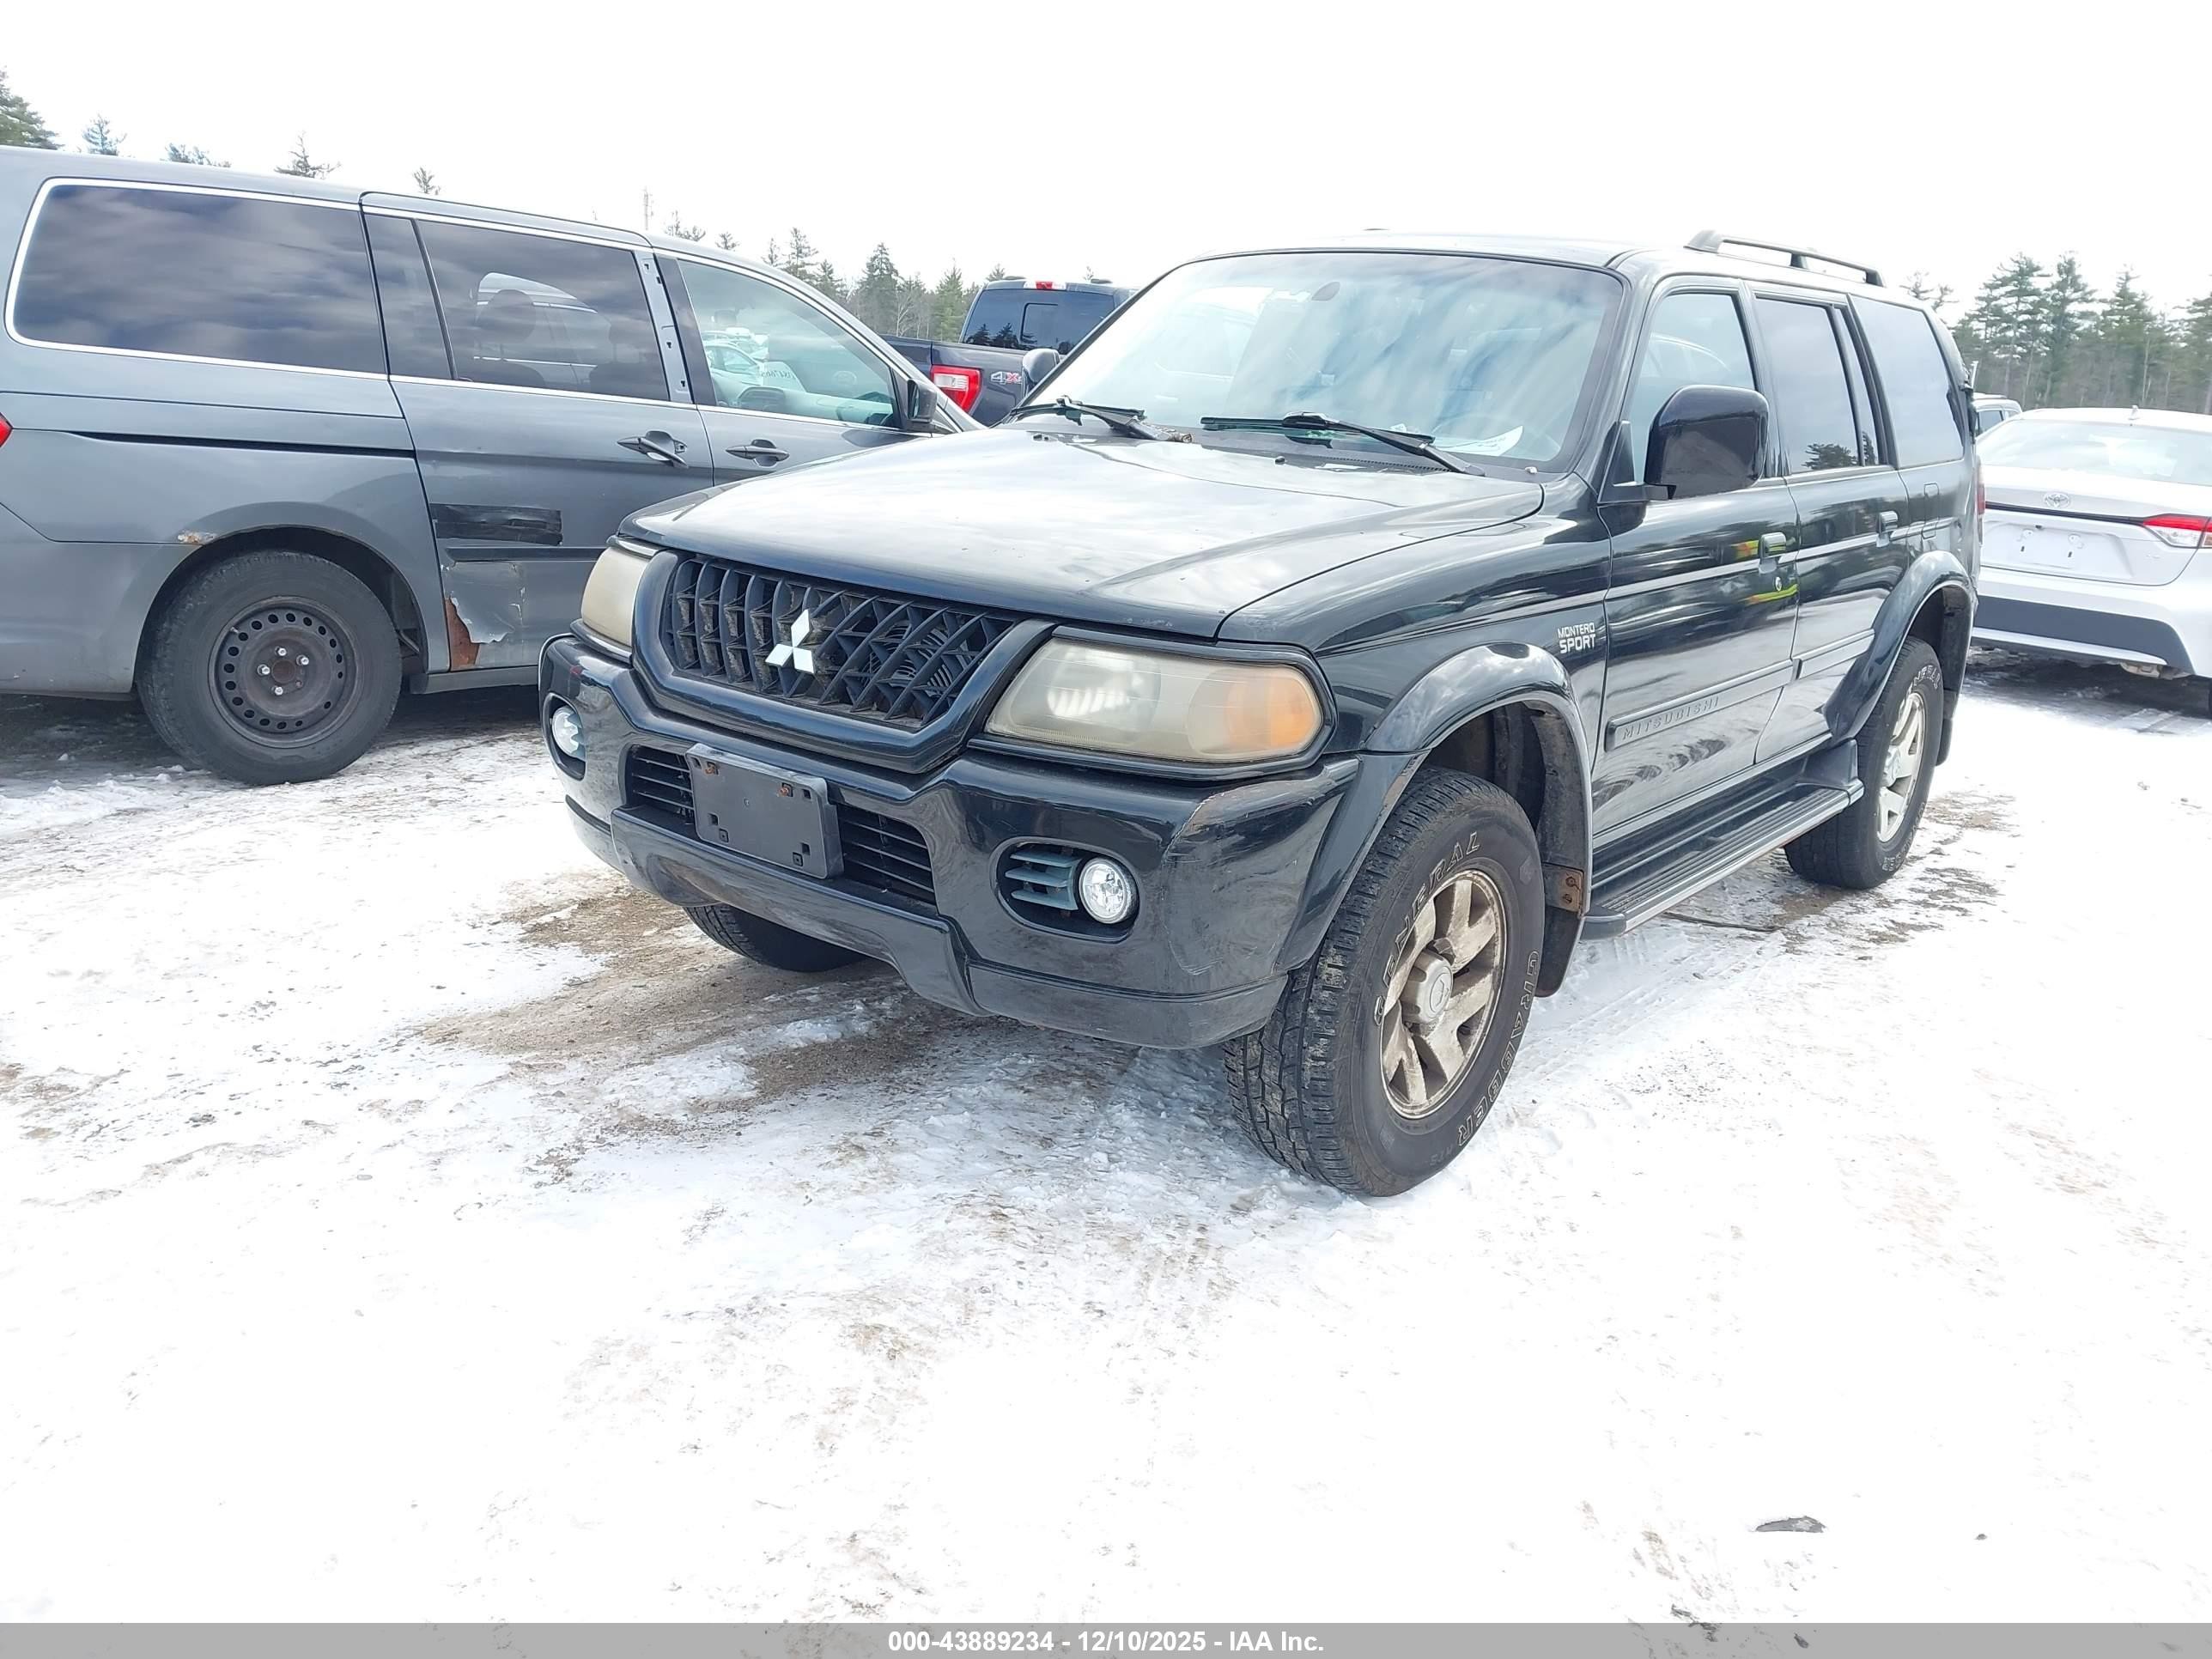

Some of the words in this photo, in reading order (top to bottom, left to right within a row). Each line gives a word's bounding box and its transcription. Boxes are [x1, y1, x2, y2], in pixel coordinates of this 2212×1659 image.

[1558, 623, 1595, 638] MONTERO
[1559, 634, 1595, 653] SPORT
[1622, 696, 1719, 740] MITSUBISHI
[1458, 951, 1540, 1146] GRABBER
